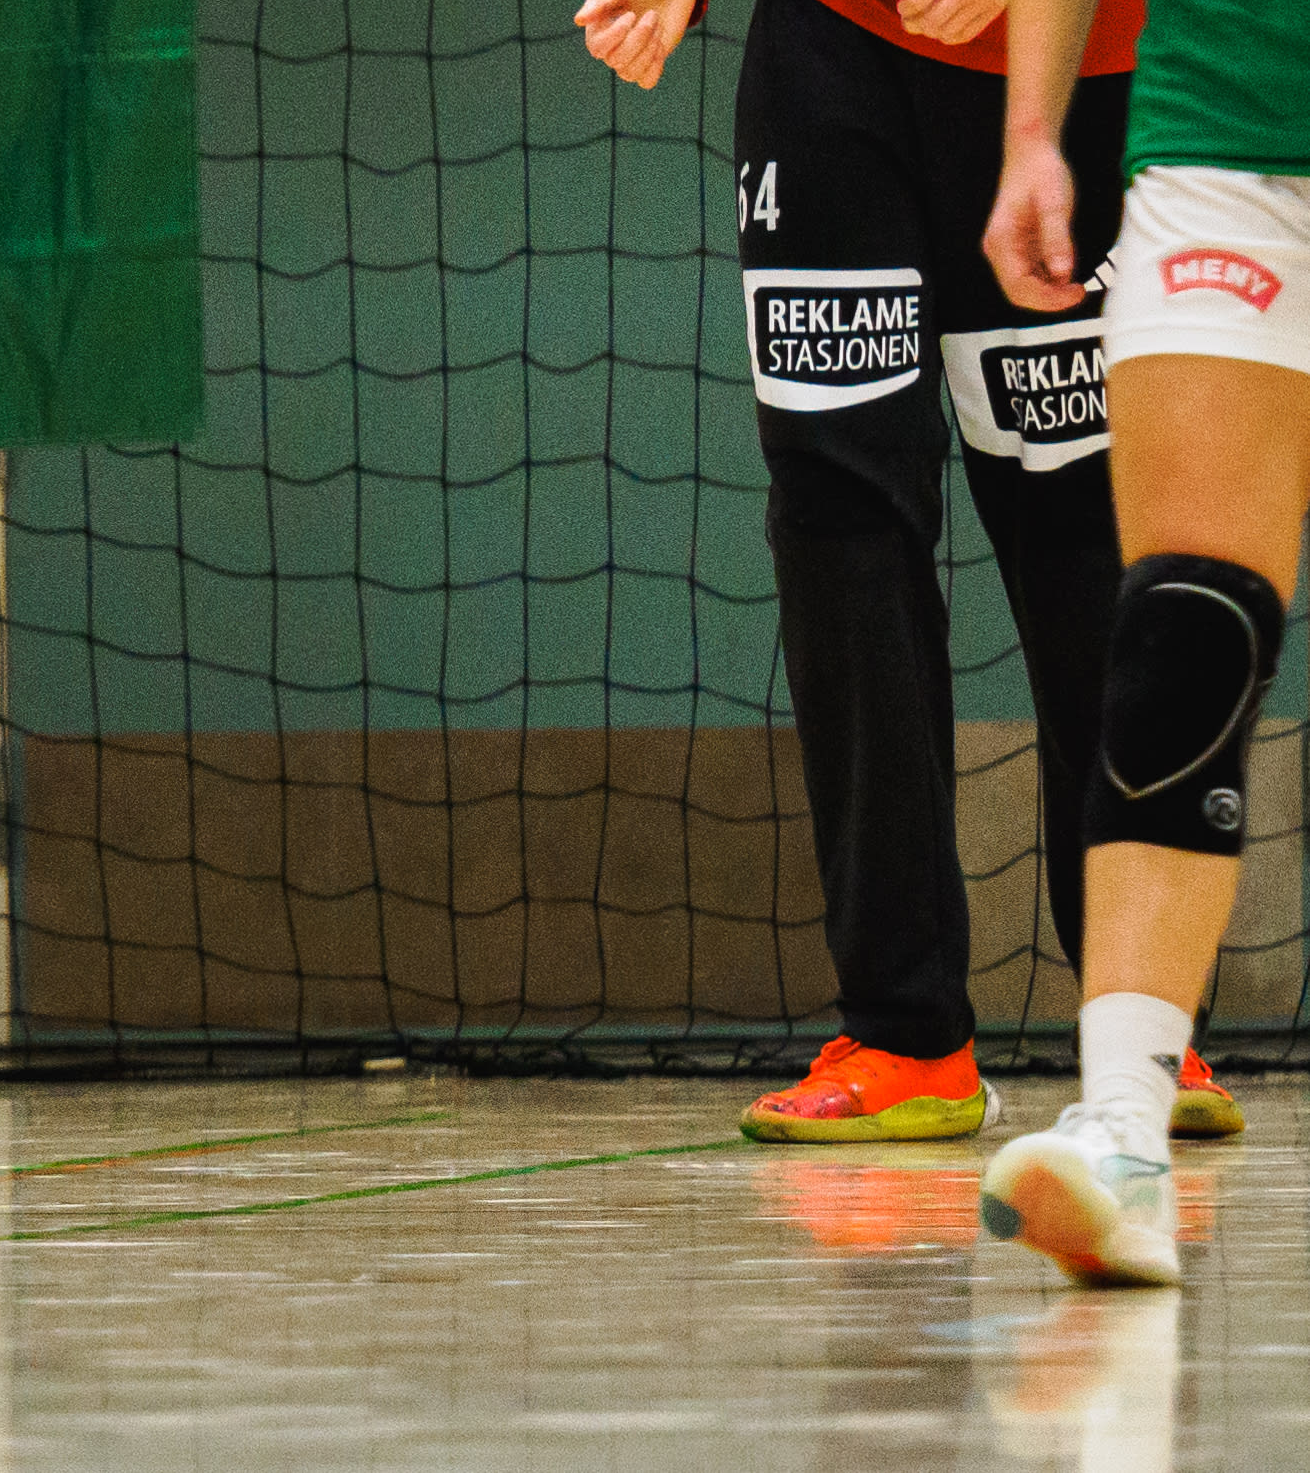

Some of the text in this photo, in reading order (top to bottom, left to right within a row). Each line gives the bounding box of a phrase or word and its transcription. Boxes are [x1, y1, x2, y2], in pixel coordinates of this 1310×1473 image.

[739, 161, 780, 234] 64
[1172, 258, 1269, 296] MENY
[768, 296, 919, 334] REKLAME
[769, 332, 919, 372] STASJONEN
